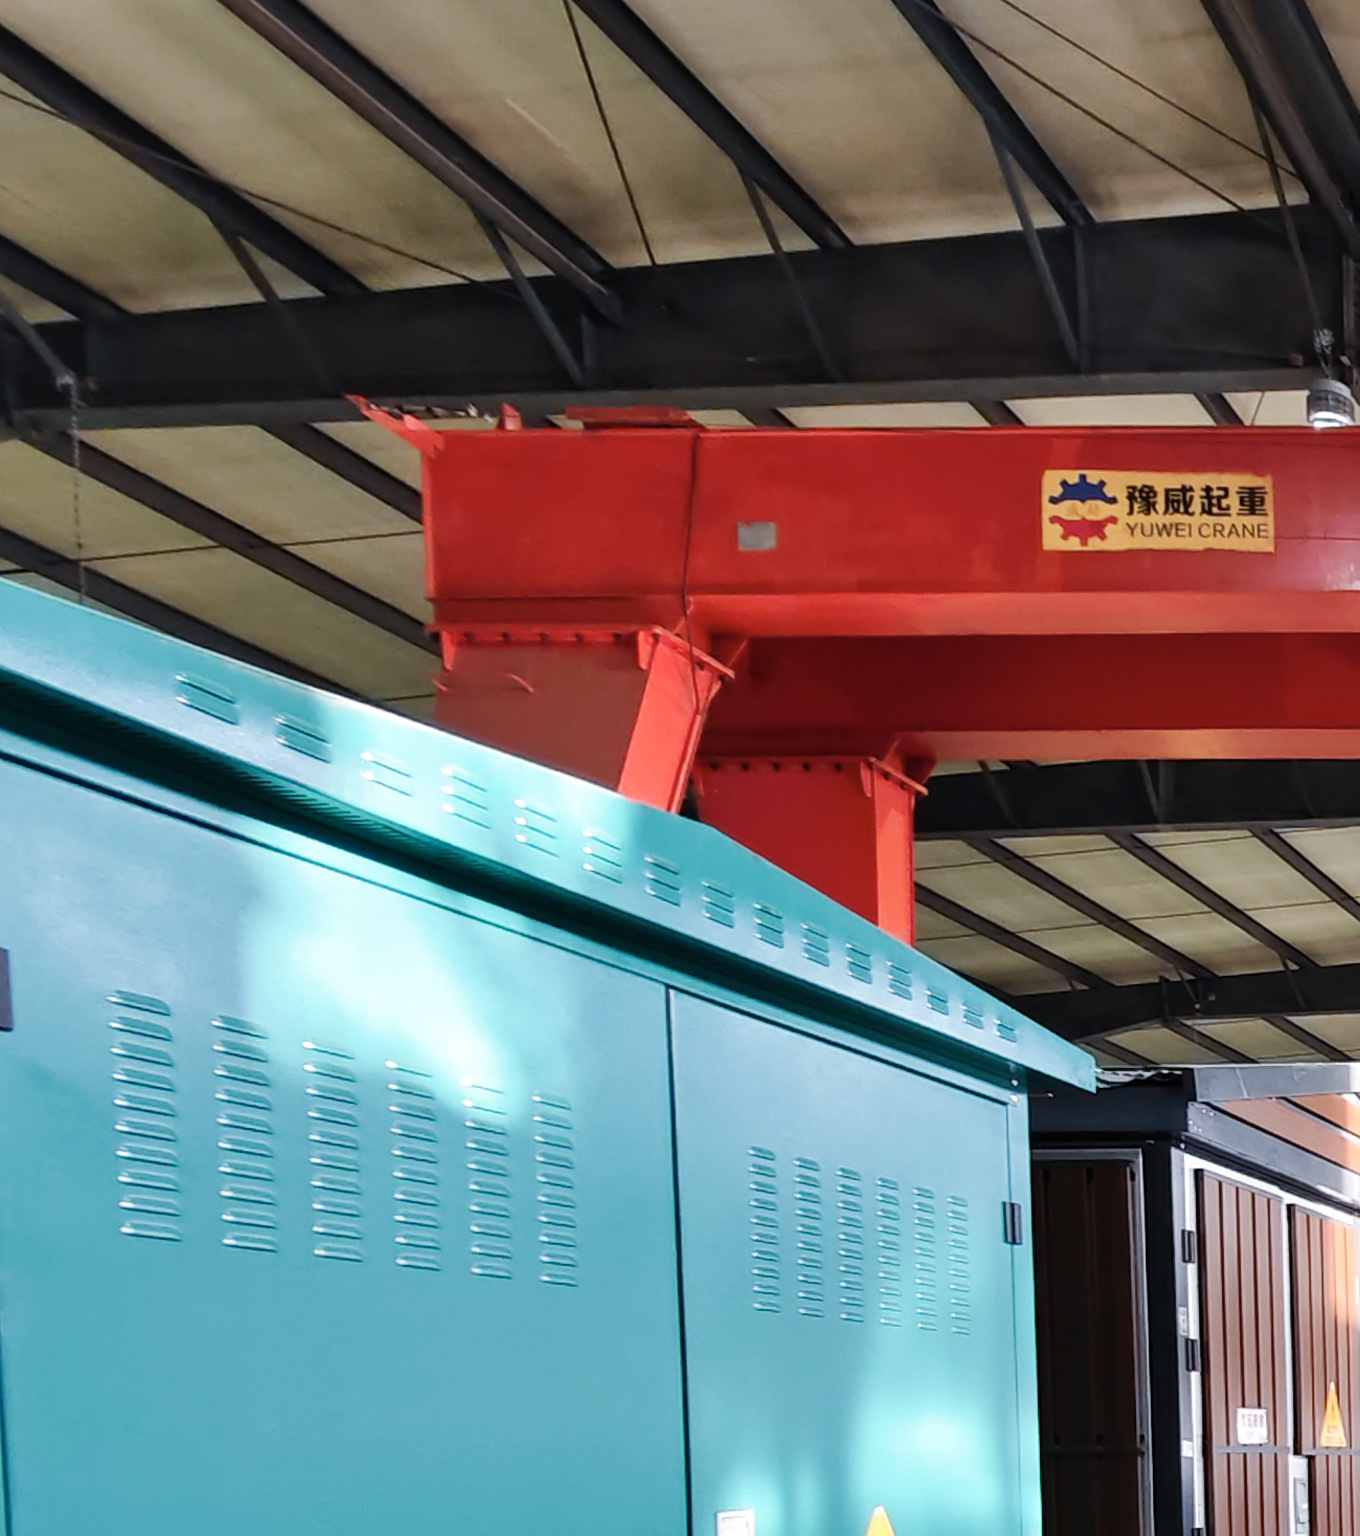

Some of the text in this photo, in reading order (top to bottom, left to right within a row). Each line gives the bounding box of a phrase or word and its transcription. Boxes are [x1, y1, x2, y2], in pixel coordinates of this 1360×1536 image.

[1125, 484, 1269, 517] 豫威起重
[1125, 522, 1269, 539] YUWEI CRANE
